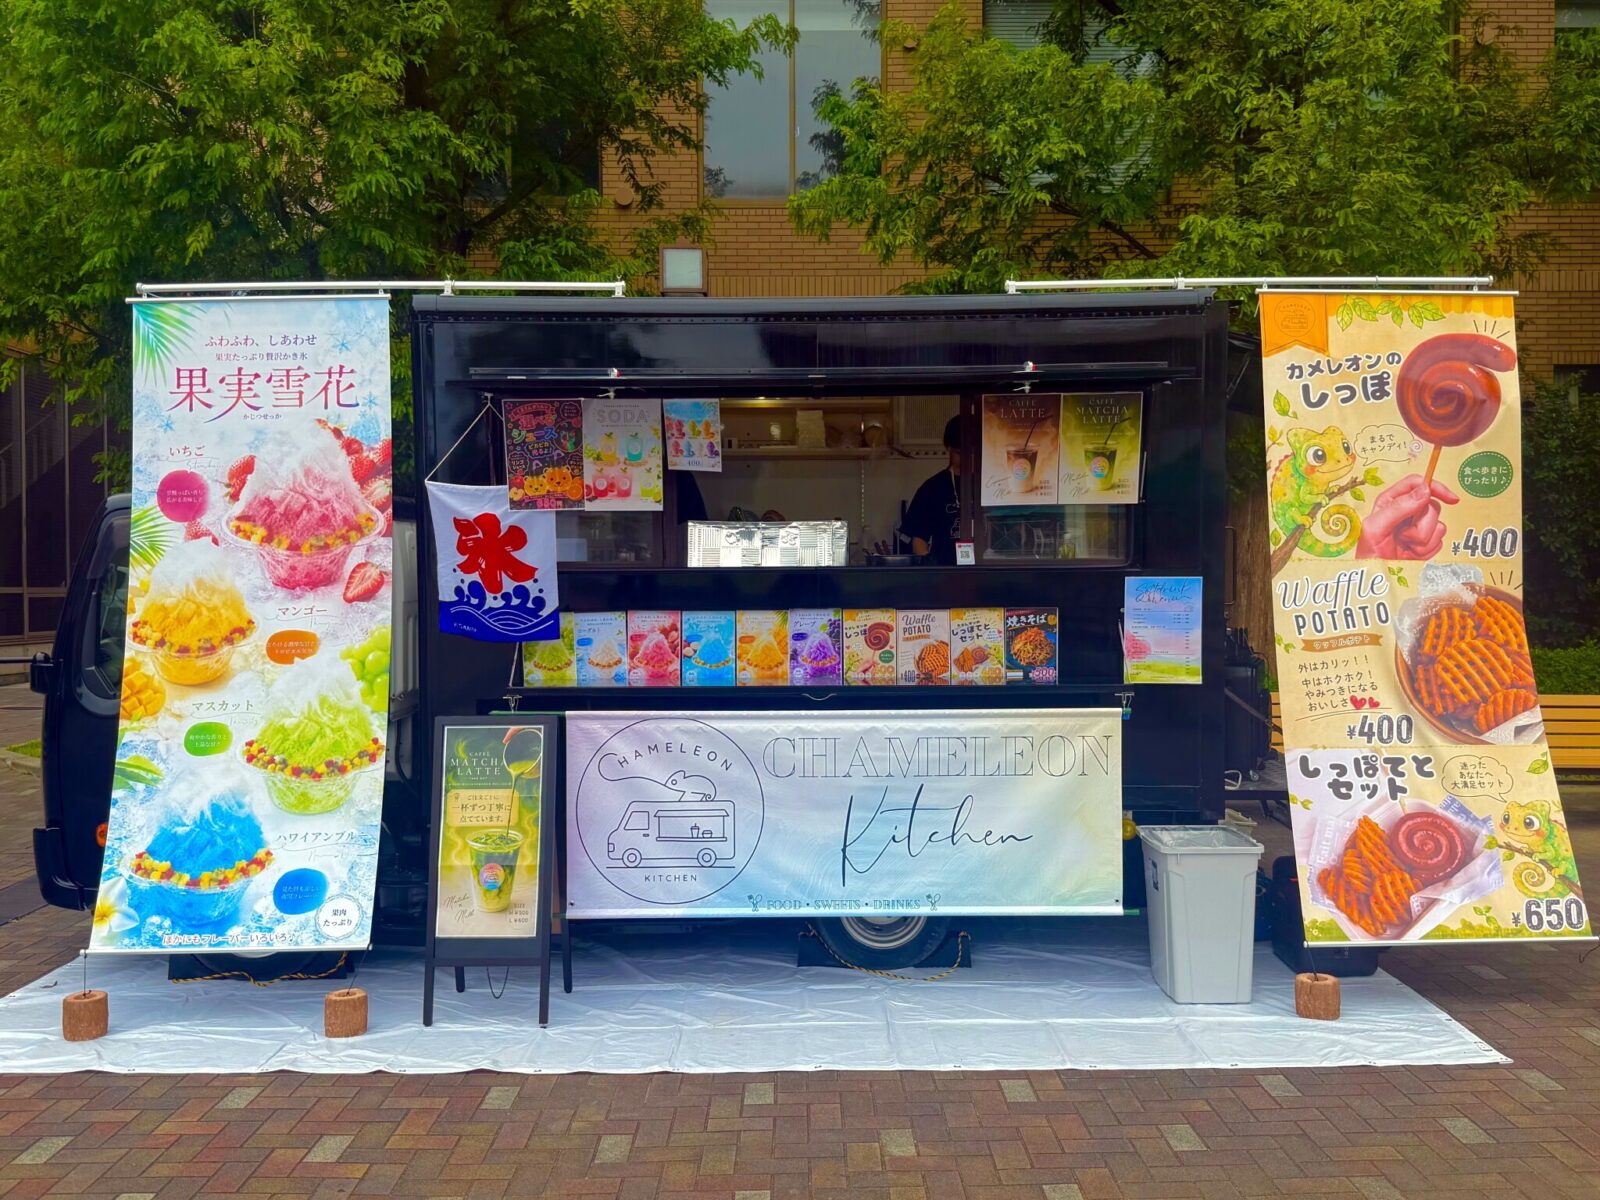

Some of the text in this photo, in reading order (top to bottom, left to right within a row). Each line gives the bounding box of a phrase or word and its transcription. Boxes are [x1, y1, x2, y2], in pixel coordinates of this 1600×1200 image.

[215, 352, 309, 362] 果実たっぷり贅沢かき氷
[1286, 352, 1402, 380] カメレオンの
[165, 364, 361, 424] 果実雪花
[1301, 371, 1392, 409] しっぽ
[596, 408, 649, 424] SODA
[1001, 407, 1046, 419] LATTE
[1082, 415, 1121, 424] LATTE
[1369, 433, 1395, 444] まるで
[169, 445, 206, 457] いちご
[1463, 466, 1508, 476] 食べ歩きに
[1452, 527, 1518, 558] ¥400
[452, 512, 540, 595] 氷
[1276, 568, 1389, 609] Waffle
[278, 605, 328, 616] マンゴー
[902, 613, 937, 626] Waffle
[1294, 601, 1390, 636] POTATO
[903, 624, 932, 636] POTATO
[1304, 680, 1379, 701] やみつきになる
[191, 699, 254, 712] マスカット
[1308, 697, 1350, 713] おいしさ
[1346, 714, 1414, 745] ¥400
[763, 735, 1114, 779] CHAMELEON
[457, 767, 501, 776] LATTE
[1298, 754, 1435, 779] しっぽてと
[1458, 771, 1494, 780] あなたへ
[1327, 777, 1409, 801] セット
[1450, 780, 1505, 790] 大満足セット
[452, 802, 512, 812] 一杯ずつ丁寧に
[841, 783, 1034, 888] Kitchen
[644, 874, 698, 883] KITCHEN
[766, 899, 922, 911] FOOD SWEETS DRINKS
[331, 908, 348, 917] 果肉
[1511, 898, 1586, 932] ¥650
[322, 918, 353, 928] たっぷり
